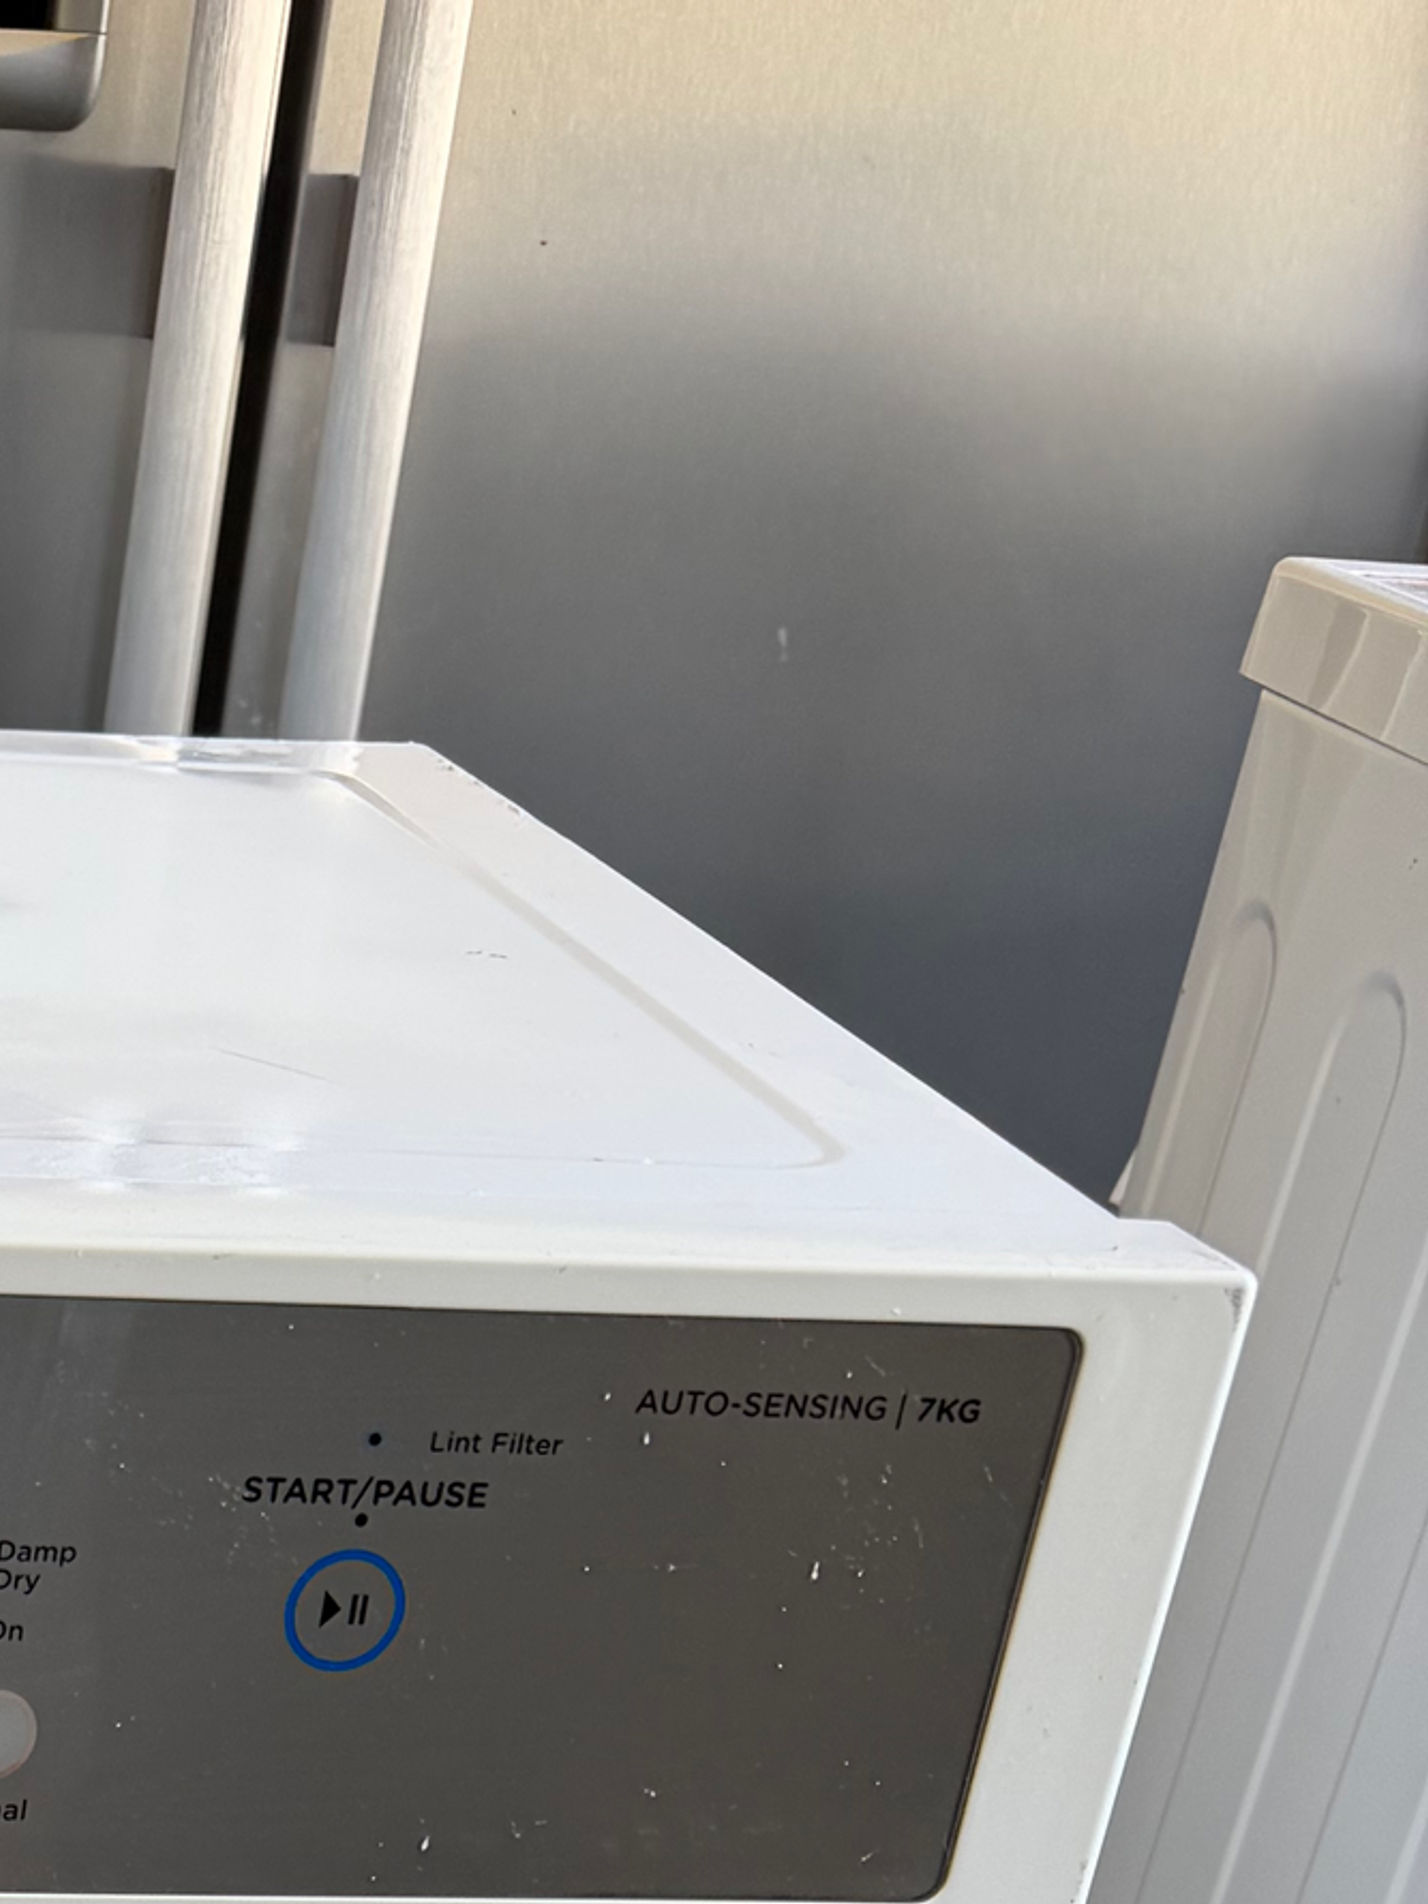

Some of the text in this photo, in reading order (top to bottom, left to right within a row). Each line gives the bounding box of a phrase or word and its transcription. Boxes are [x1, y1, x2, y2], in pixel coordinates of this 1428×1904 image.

[635, 1389, 888, 1423] AUTO-SENSING
[917, 1395, 983, 1425] 7KG
[429, 1431, 564, 1457] Lint Filter
[242, 1475, 489, 1510] START/PAUSE
